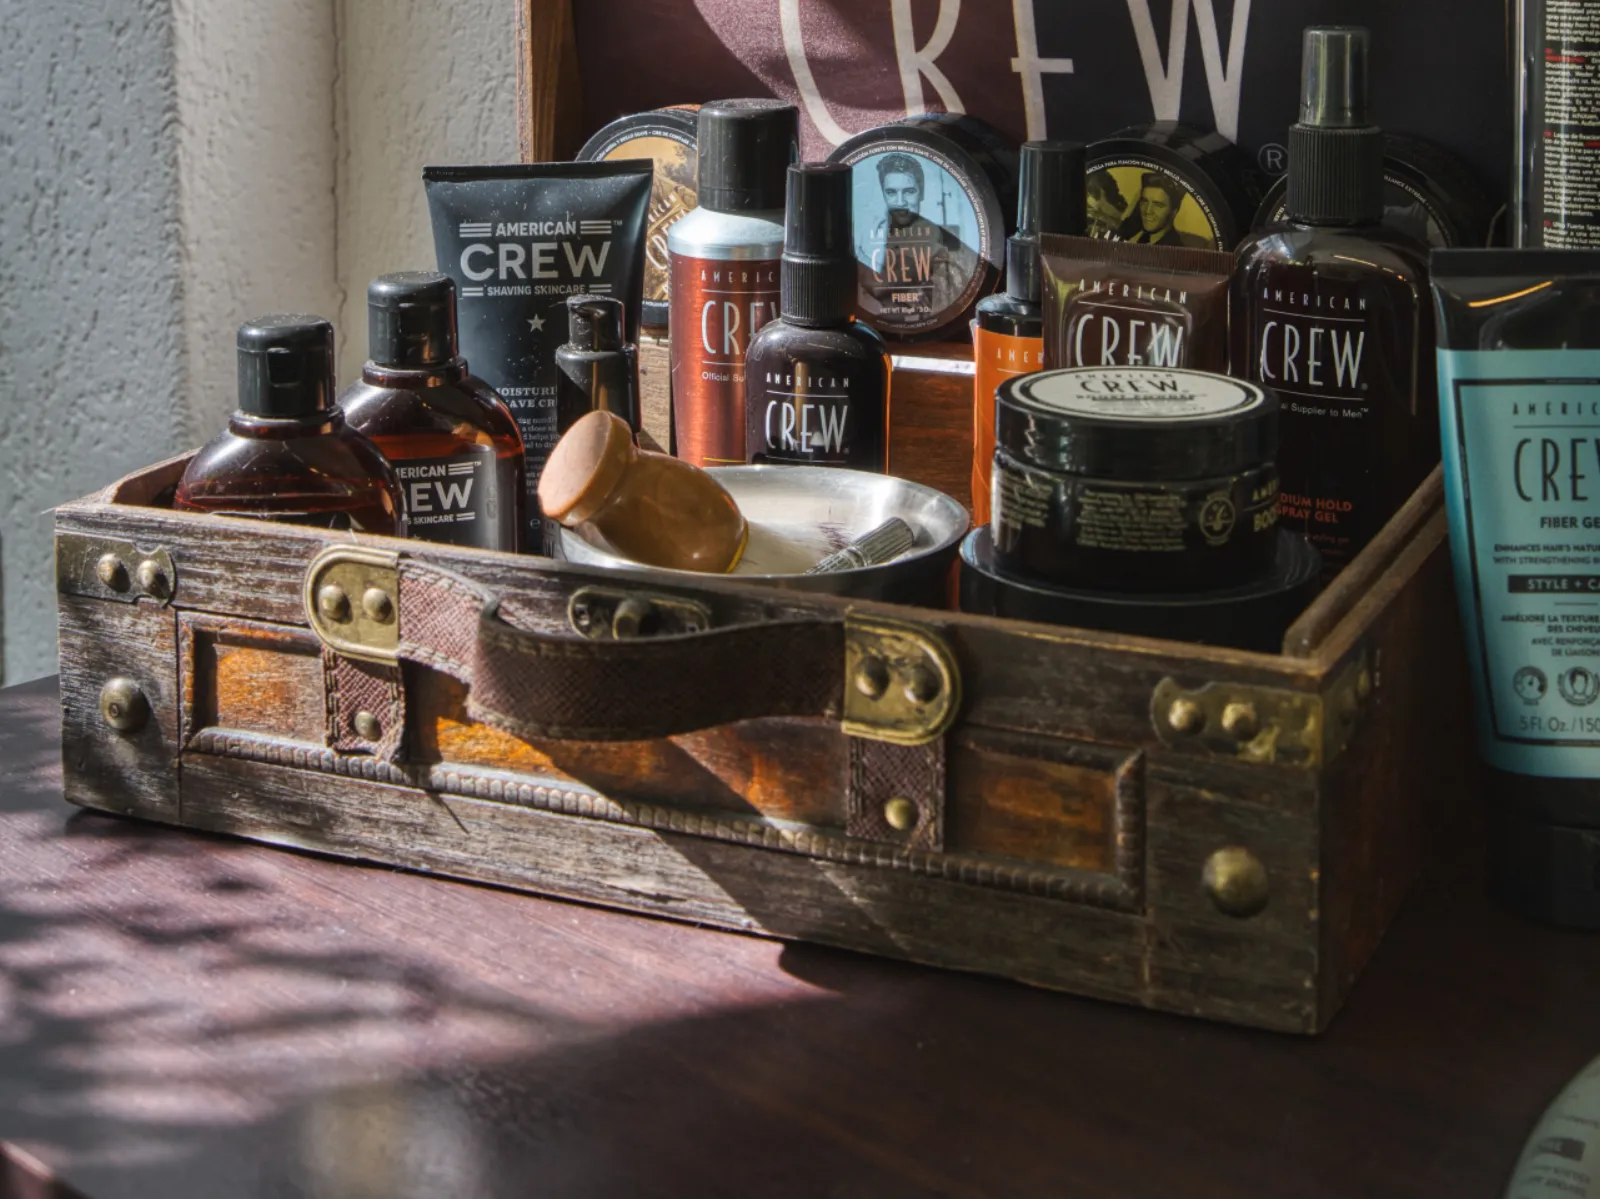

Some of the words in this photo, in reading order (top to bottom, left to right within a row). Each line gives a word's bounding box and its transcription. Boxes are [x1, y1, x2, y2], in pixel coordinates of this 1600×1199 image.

[495, 221, 577, 237] AMERICAN
[460, 240, 612, 282] CREW
[871, 246, 932, 283] CREW
[701, 269, 774, 283] AMERIC
[487, 285, 532, 297] SHAVING
[534, 284, 585, 296] SKINCARE
[891, 292, 920, 303] FIBER
[1078, 278, 1187, 304] AMERICAN
[1263, 287, 1366, 311] AMERICAN
[1075, 313, 1184, 367] CREW
[1262, 321, 1365, 389] CREW
[702, 371, 729, 382] Official
[766, 372, 849, 388] AMERICAN
[1080, 379, 1179, 394] CREW
[508, 399, 536, 408] AVE
[1291, 402, 1326, 416] Supplier
[1330, 408, 1339, 417] to
[765, 400, 849, 453] CREW
[396, 465, 447, 479] ERICAN
[1513, 438, 1600, 502] CRE
[411, 478, 474, 513] EW
[1280, 493, 1312, 507] DIUM
[1315, 497, 1352, 512] HOLD
[413, 514, 454, 525] SKINCARE
[1276, 505, 1311, 519] SPRAY
[1314, 511, 1339, 523] GEL
[1540, 516, 1578, 529] FIBER
[1528, 578, 1569, 590] STYLE
[1547, 614, 1558, 622] LA
[1560, 614, 1599, 623] TEXTURE
[1547, 624, 1563, 633] DES
[1531, 637, 1554, 646] AVEC
[1551, 649, 1563, 657] DE
